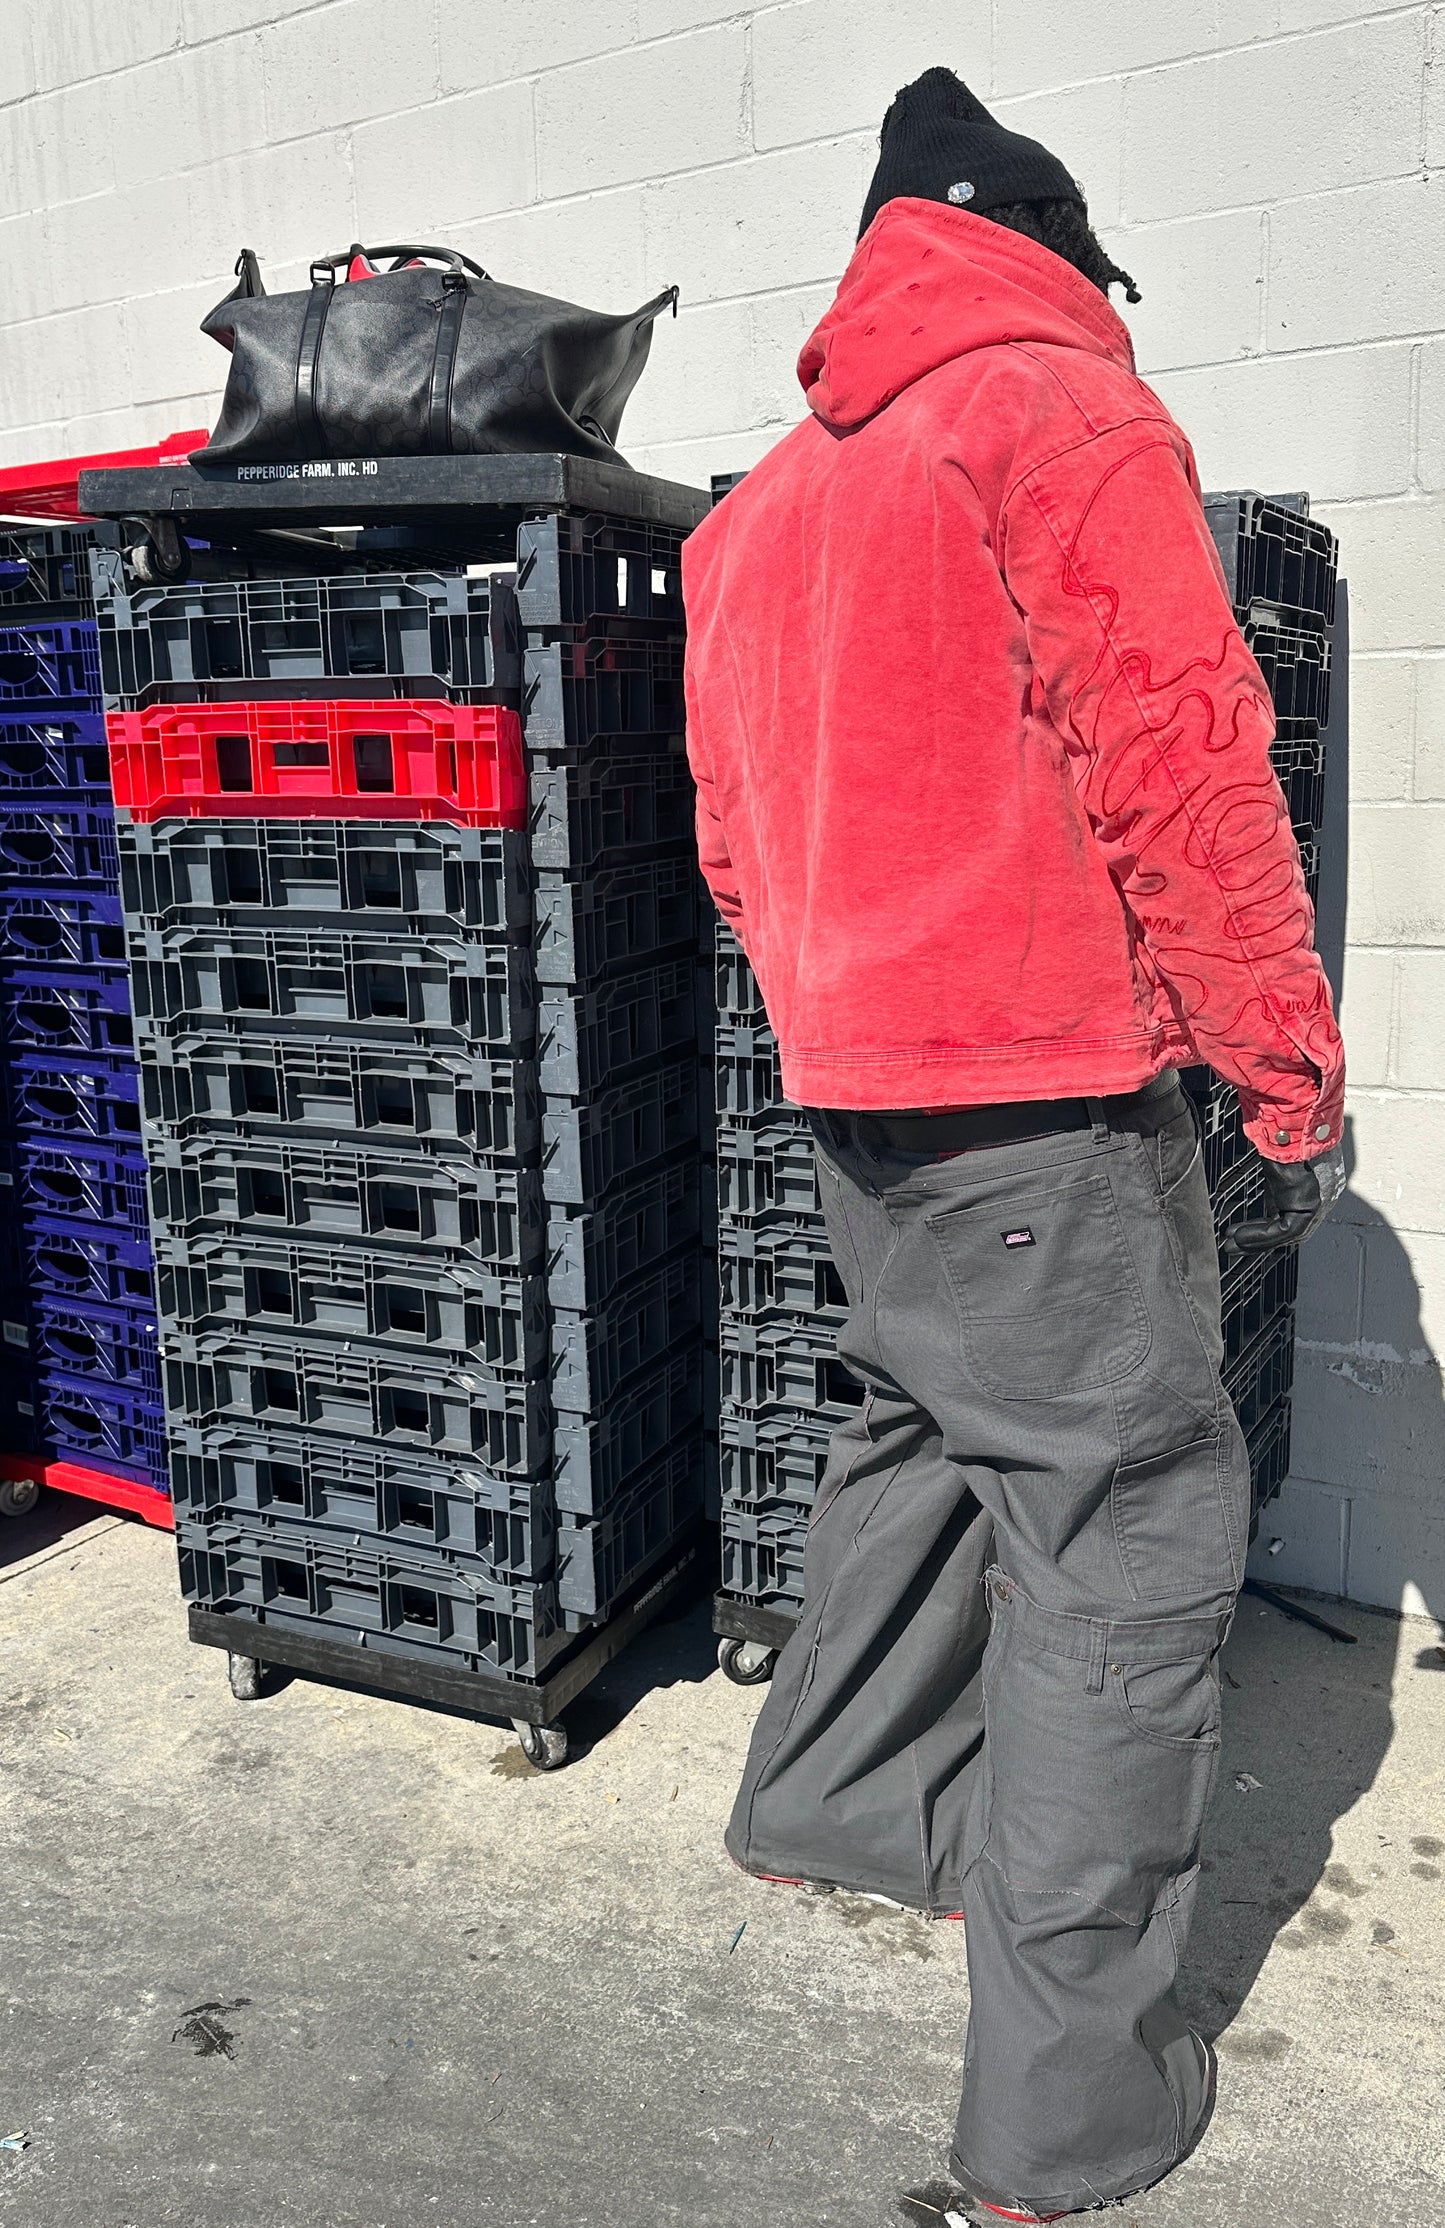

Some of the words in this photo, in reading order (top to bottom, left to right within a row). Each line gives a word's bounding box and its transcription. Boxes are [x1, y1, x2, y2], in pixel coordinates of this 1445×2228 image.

[237, 464, 300, 480] PEPPERIDGE
[337, 461, 360, 477] INC.
[362, 460, 378, 476] HD
